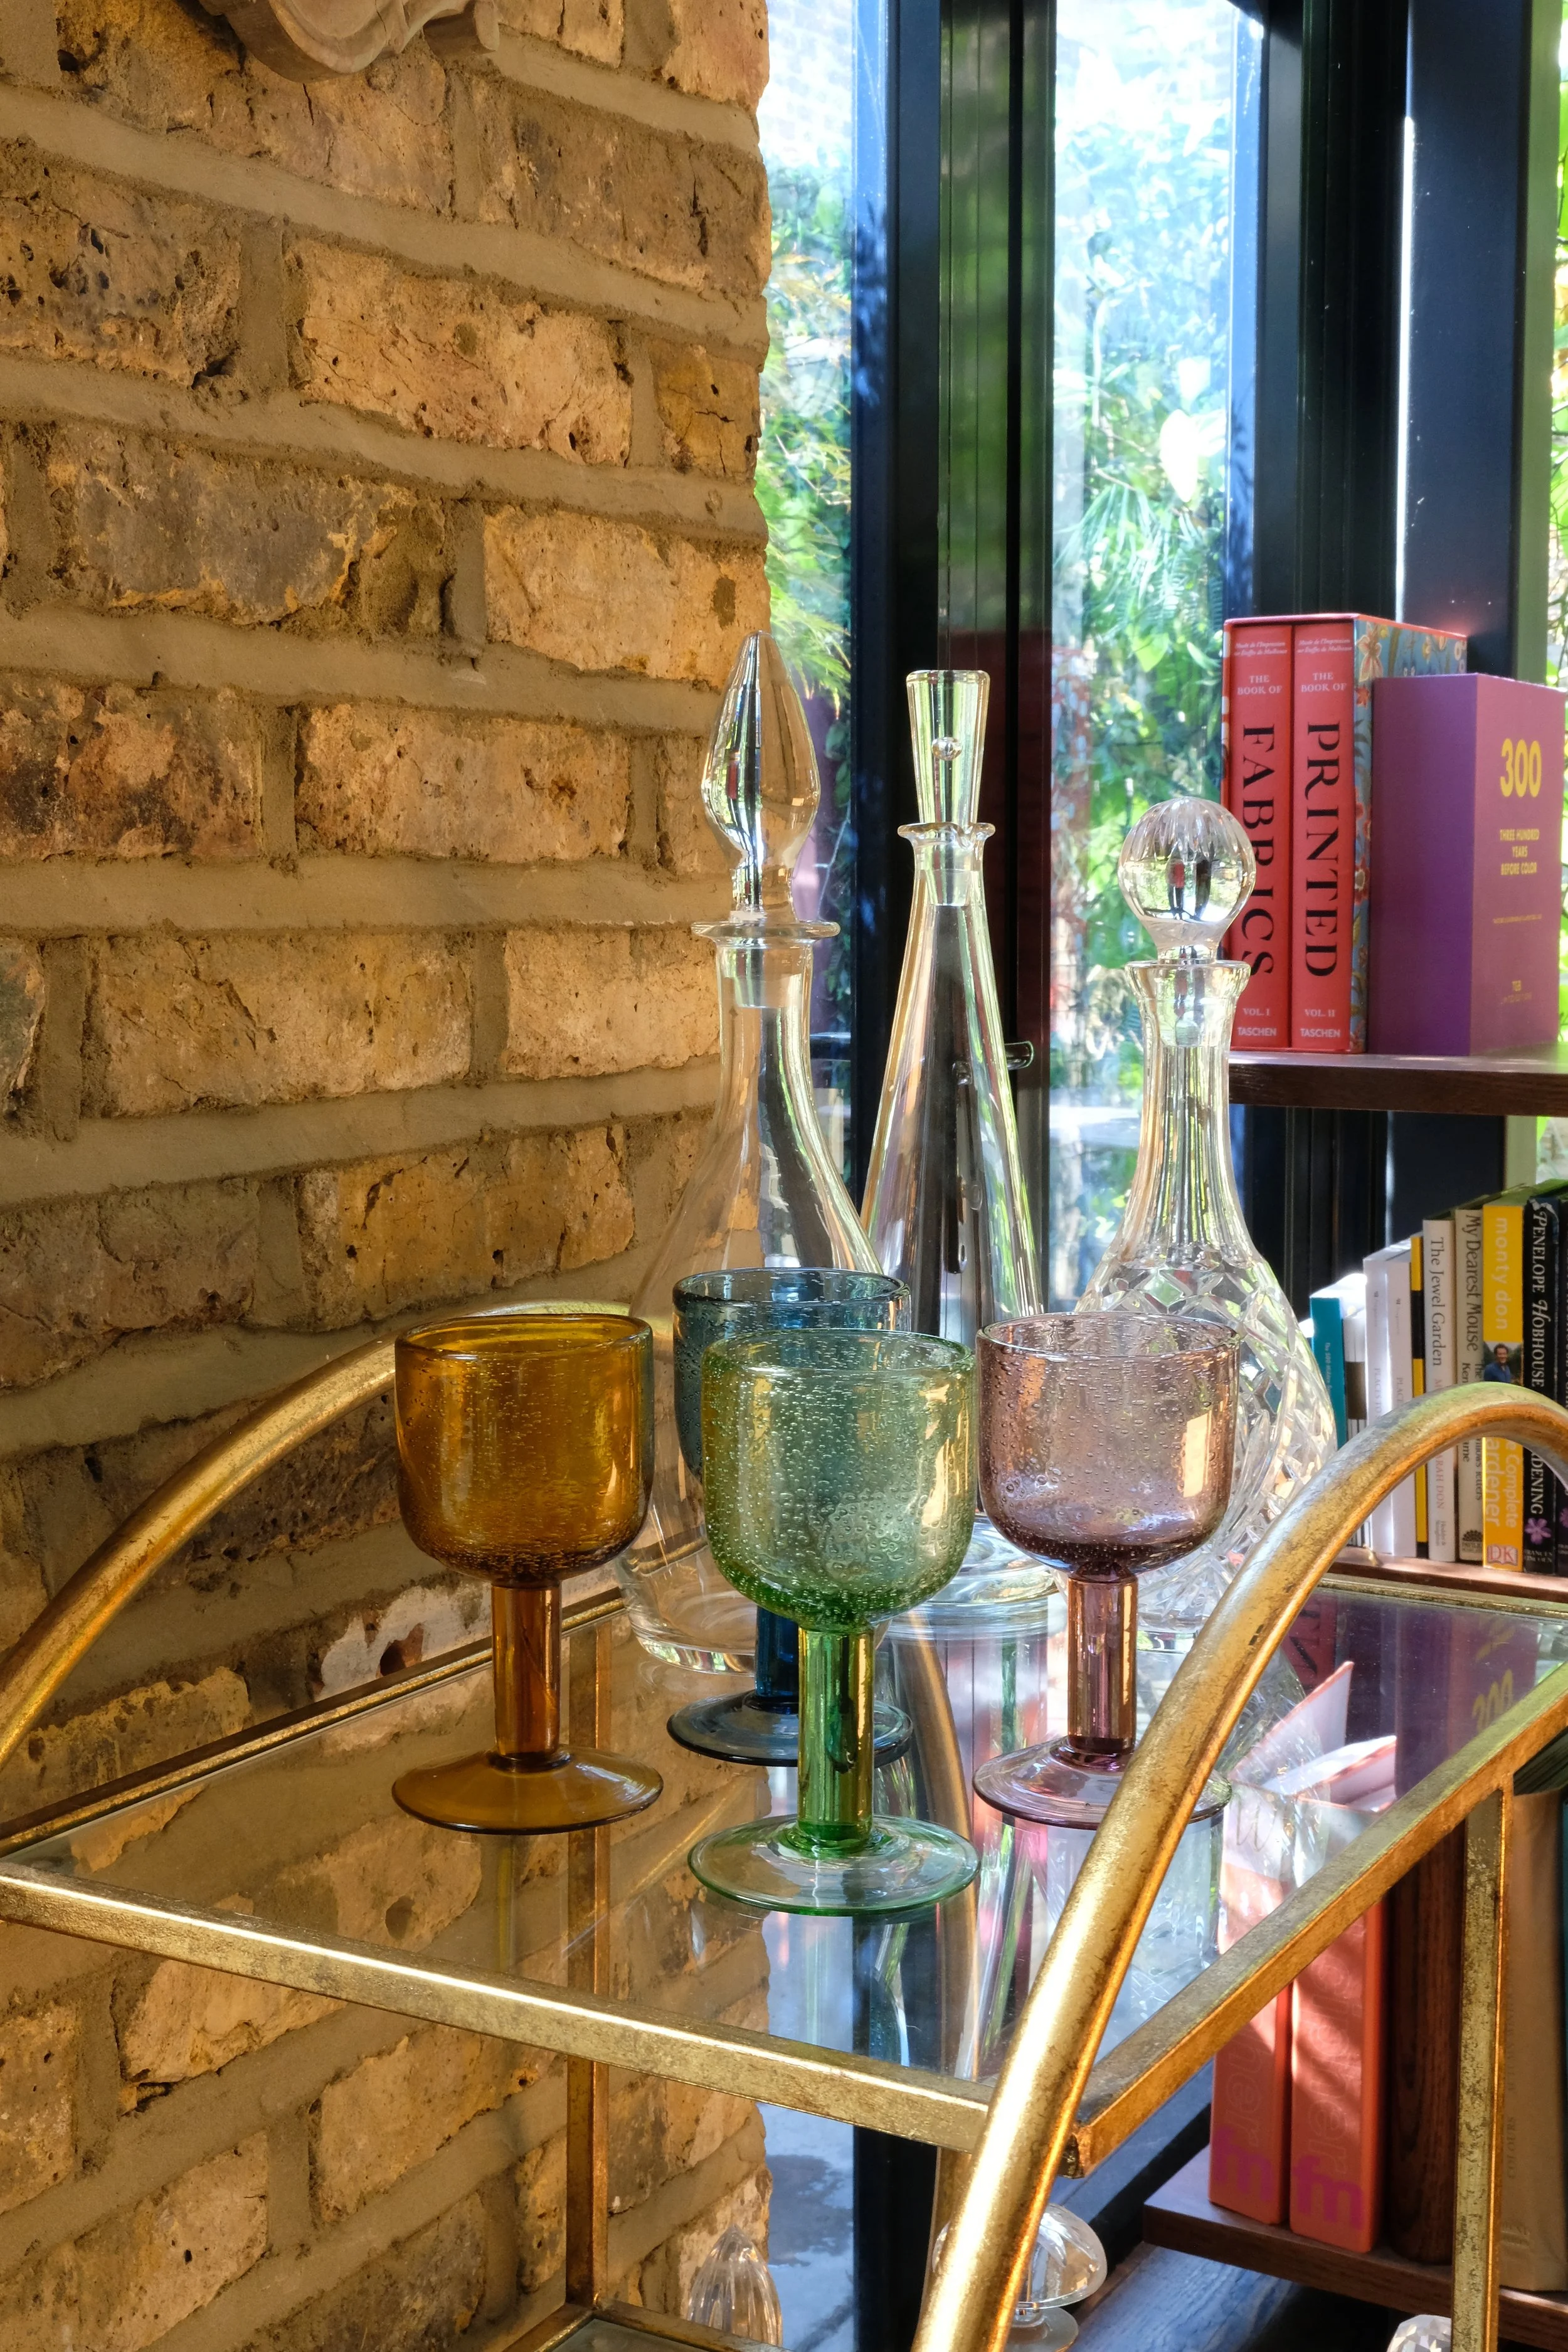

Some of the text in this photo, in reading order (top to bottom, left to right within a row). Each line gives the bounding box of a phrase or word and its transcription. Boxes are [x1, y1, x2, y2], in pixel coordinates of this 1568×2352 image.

[1249, 675, 1269, 684] THE
[1313, 672, 1333, 681] THE
[1237, 686, 1283, 696] BOOK OF
[1301, 684, 1330, 693] BOOK
[1500, 738, 1542, 798] 300
[1500, 829, 1515, 841] THREE
[1241, 724, 1275, 976] FABRICS
[1305, 721, 1340, 977] PRINTED
[1512, 845, 1528, 857] YEARS
[1501, 861, 1537, 875] BEFORE COLOR
[1242, 1008, 1270, 1016] VOL. I
[1304, 1009, 1336, 1017] VOL. II
[1237, 1027, 1276, 1036] TASCHEN
[1300, 1028, 1340, 1037] TASCHEN
[1431, 1237, 1444, 1266] The
[1462, 1214, 1481, 1351] My Dearest Mouse
[1492, 1217, 1512, 1330] monty don
[1430, 1270, 1446, 1307] Jewel
[1432, 1313, 1446, 1365] Garden
[1530, 1210, 1551, 1515] PENELOPE HOBHOUSE DENING
[1486, 1439, 1506, 1527] ardener
[1503, 1454, 1521, 1528] Complete
[1436, 1485, 1444, 1509] DON
[1490, 1545, 1515, 1562] DK
